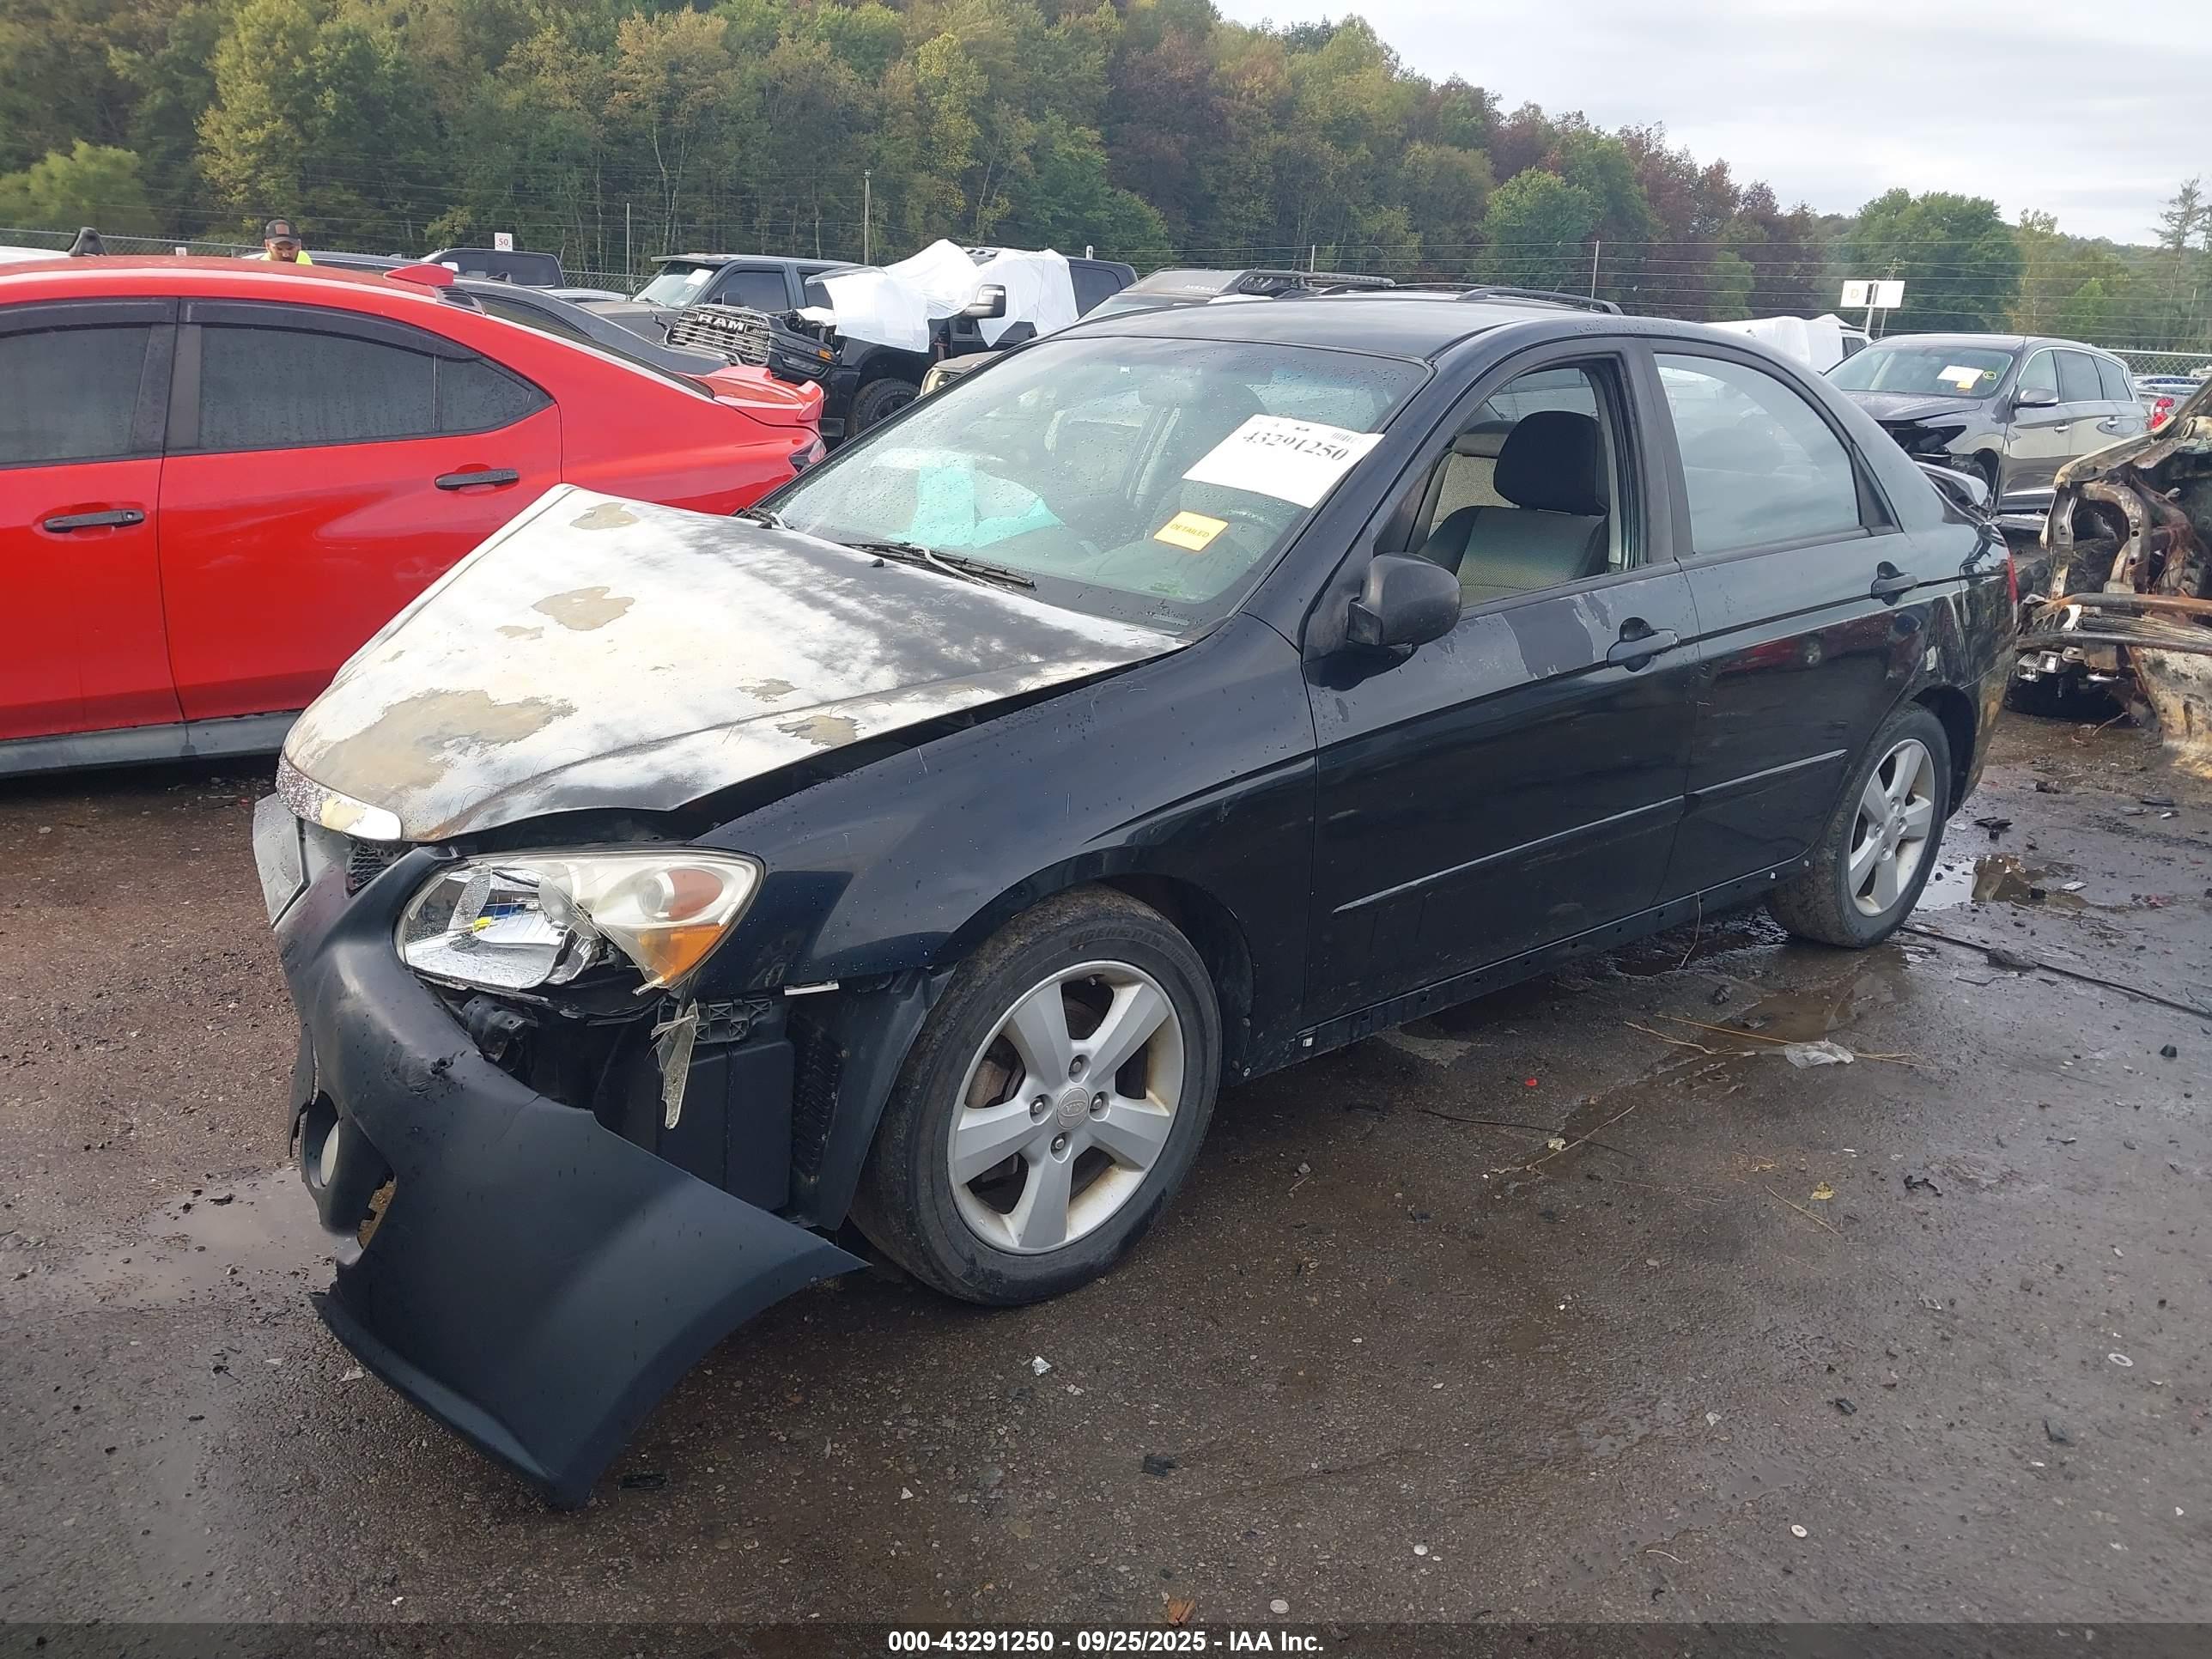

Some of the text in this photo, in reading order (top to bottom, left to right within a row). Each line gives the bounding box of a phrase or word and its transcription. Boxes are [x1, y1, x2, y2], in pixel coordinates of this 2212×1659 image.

[498, 238, 509, 246] 50
[697, 313, 744, 331] RAM
[1243, 430, 1349, 461] 43291250
[1170, 523, 1210, 538] DETAILED
